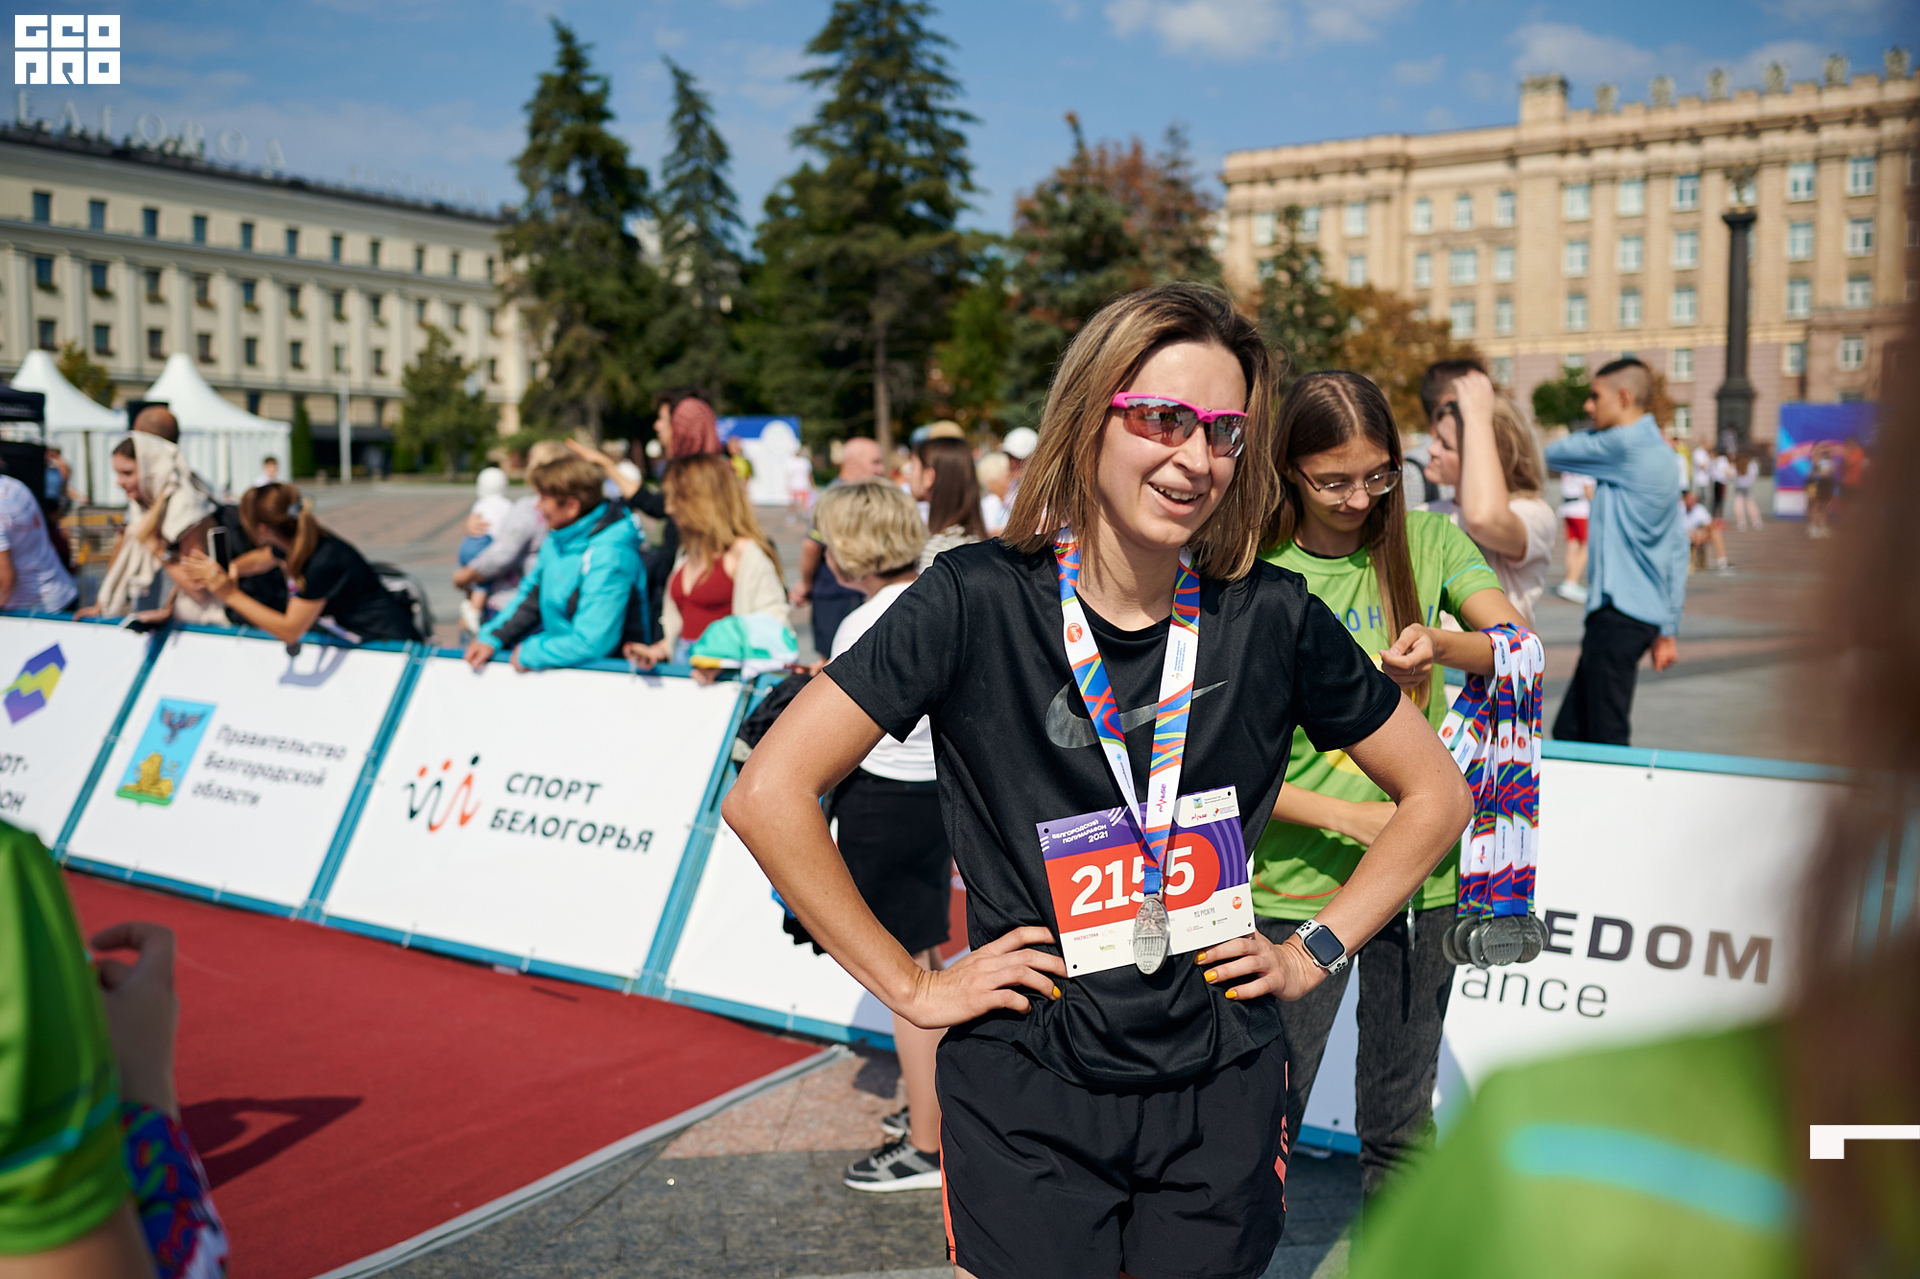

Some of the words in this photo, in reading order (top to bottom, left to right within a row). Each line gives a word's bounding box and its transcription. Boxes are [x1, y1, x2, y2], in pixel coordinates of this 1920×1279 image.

[216, 725, 347, 760] Правительство
[204, 751, 327, 786] Белгородской
[192, 780, 262, 806] области
[506, 773, 603, 804] СПОРТ
[490, 808, 655, 853] БЕЛОГОРЬЯ
[1052, 819, 1099, 839] БЕЛГОРОДСКИЙ
[1063, 824, 1107, 844] ПОЛУМАРАФОН
[1088, 830, 1109, 843] 2021
[1543, 910, 1772, 985] EDOM
[1461, 967, 1608, 1018] ance
